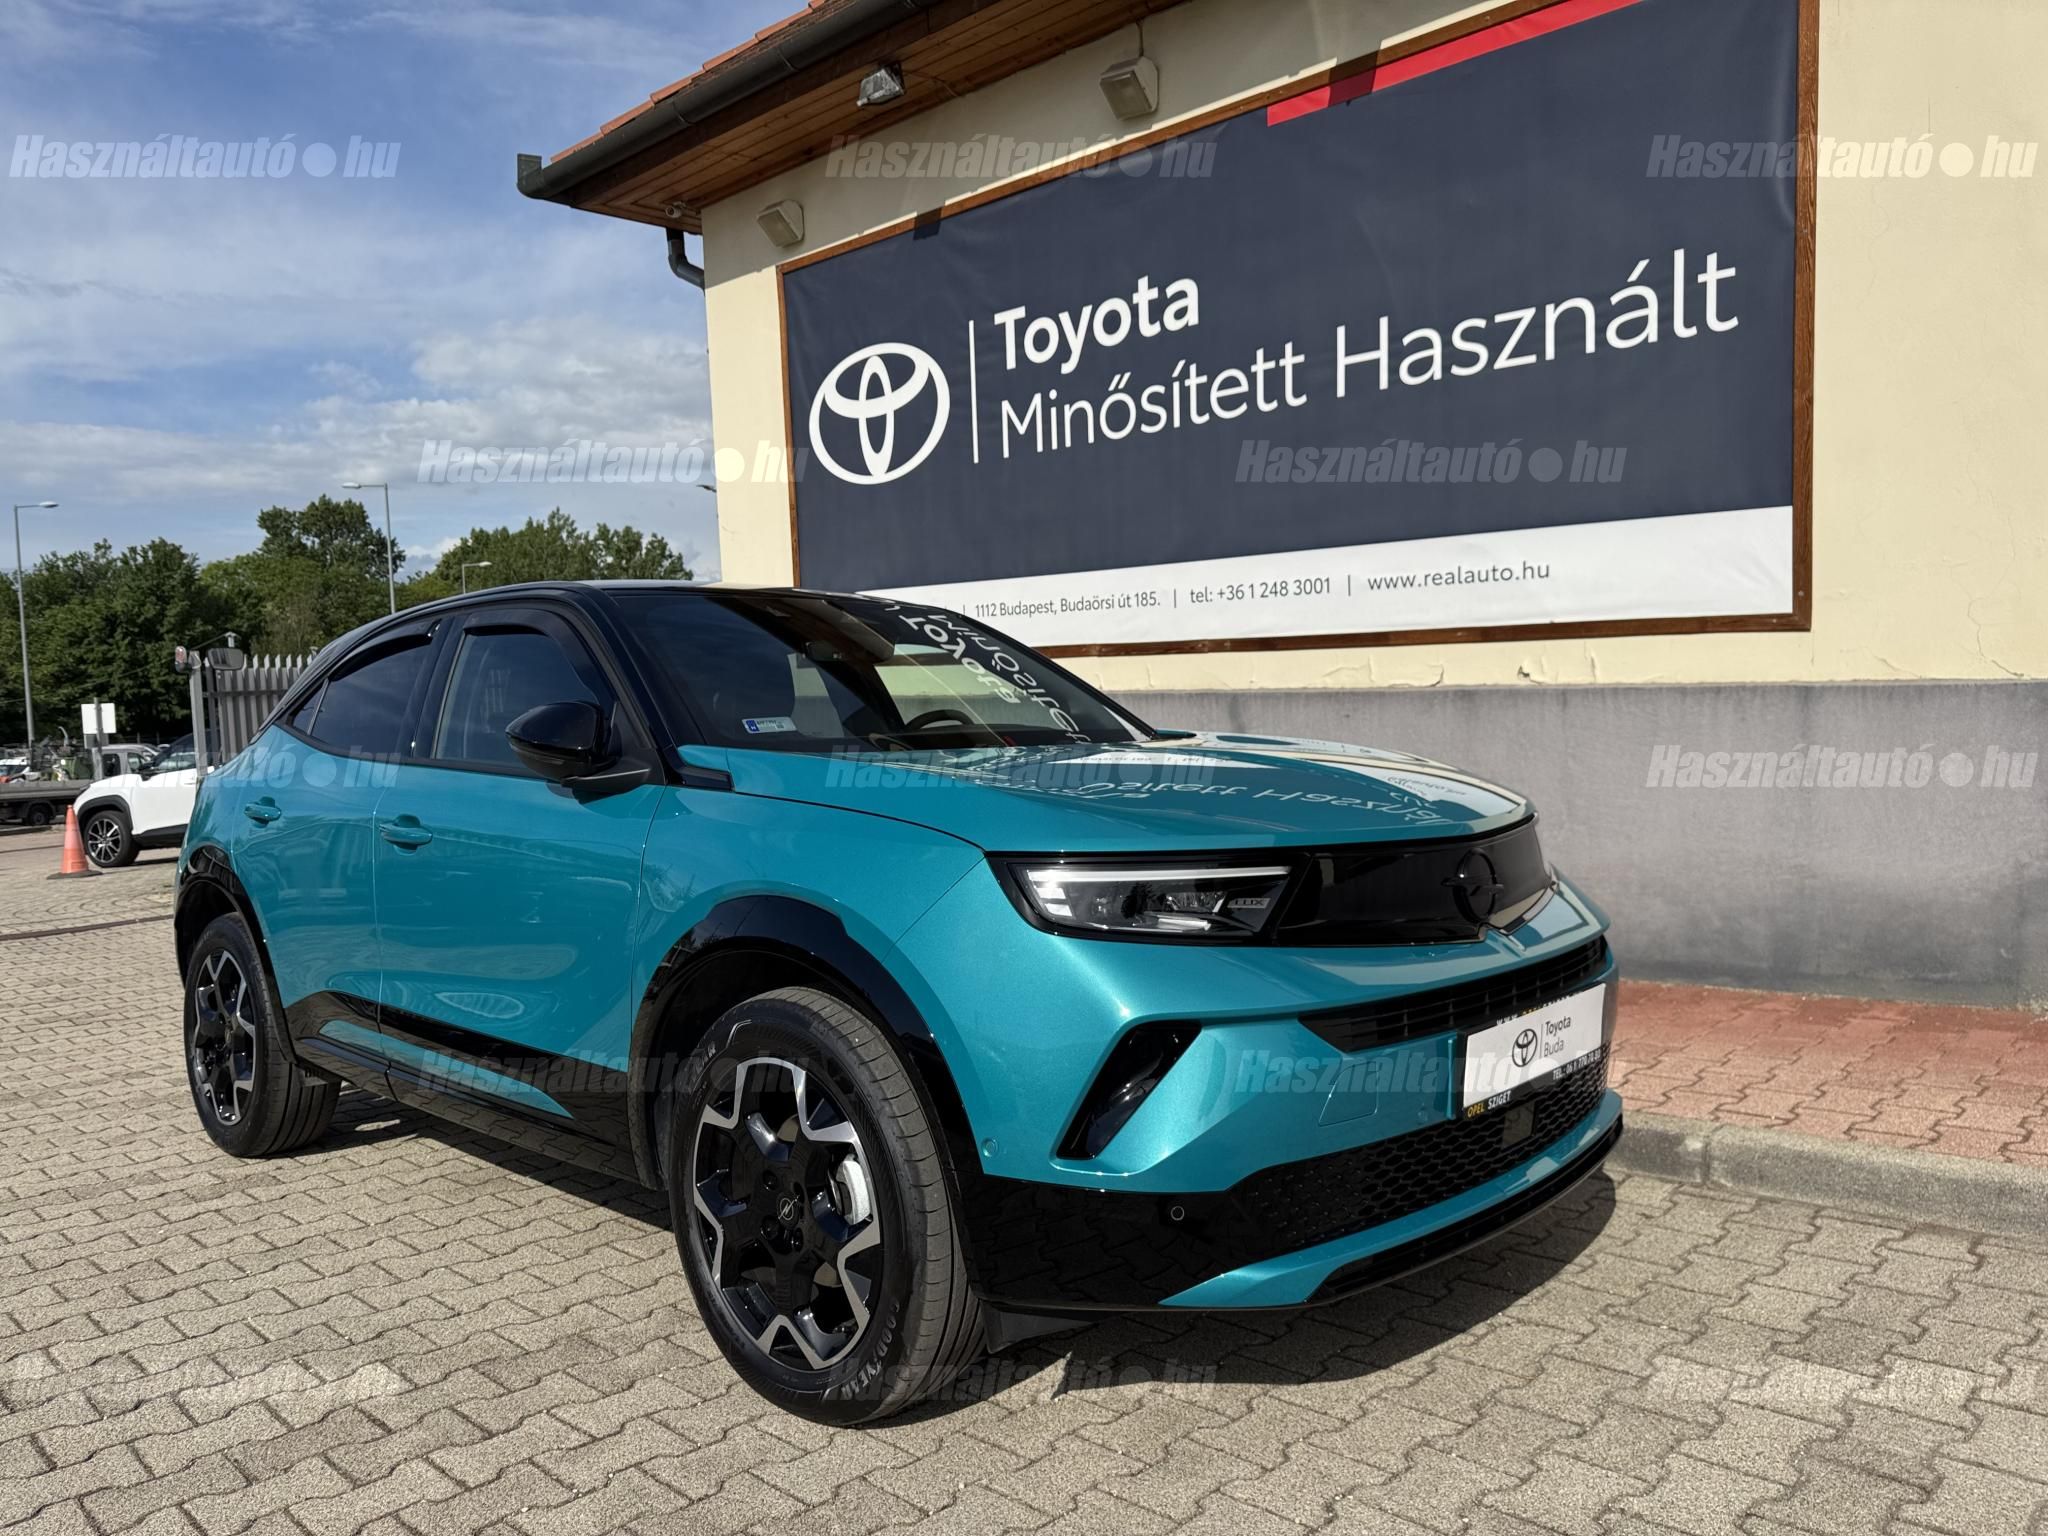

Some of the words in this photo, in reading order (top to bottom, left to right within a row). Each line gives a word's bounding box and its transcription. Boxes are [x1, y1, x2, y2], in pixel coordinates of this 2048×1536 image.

[993, 275, 1200, 374] Toyota
[1002, 341, 1307, 459] Minősített
[1336, 248, 1738, 398] Használt
[975, 602, 998, 618] 1112
[999, 599, 1057, 619] Budapest,
[1060, 593, 1115, 613] Budaörsi
[1117, 591, 1131, 609] út
[1134, 591, 1160, 608] 185.
[1190, 586, 1213, 603] tel:
[1260, 581, 1289, 598] 248
[1293, 577, 1331, 597] 3001
[1367, 561, 1550, 591] www.realauto.hu
[1545, 1015, 1572, 1037] Toyota
[1544, 1037, 1564, 1058] Buda
[1467, 1104, 1485, 1118] OPEL
[1487, 1091, 1511, 1110] SZIGET
